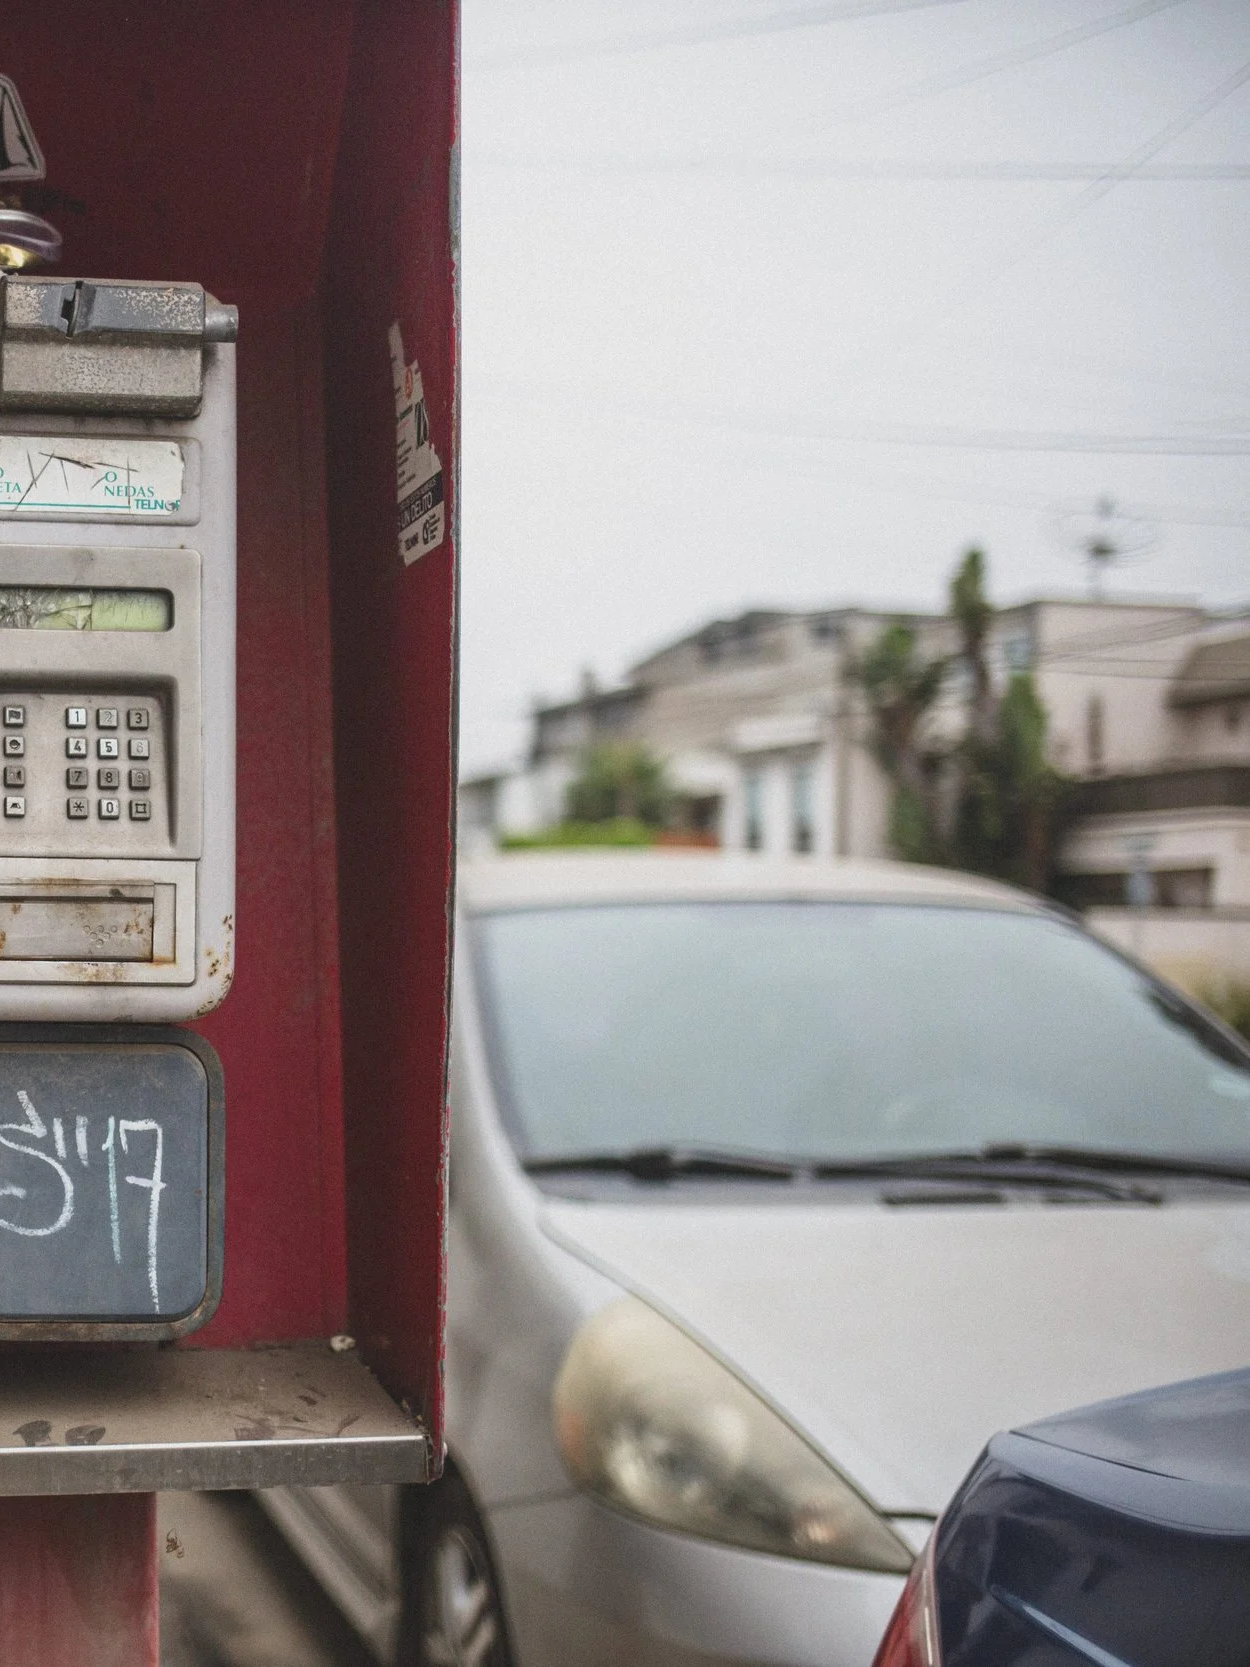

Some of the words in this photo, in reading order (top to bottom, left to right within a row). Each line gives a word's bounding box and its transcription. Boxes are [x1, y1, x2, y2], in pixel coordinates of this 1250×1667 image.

[103, 485, 155, 498] NEDAS
[102, 711, 113, 724] 2
[135, 712, 143, 724] 3
[73, 740, 82, 752] 4
[105, 741, 113, 753] 5
[136, 742, 144, 753] 6
[74, 770, 83, 782] 7
[105, 771, 113, 783] 8
[136, 772, 144, 784] 9
[106, 801, 114, 814] 0
